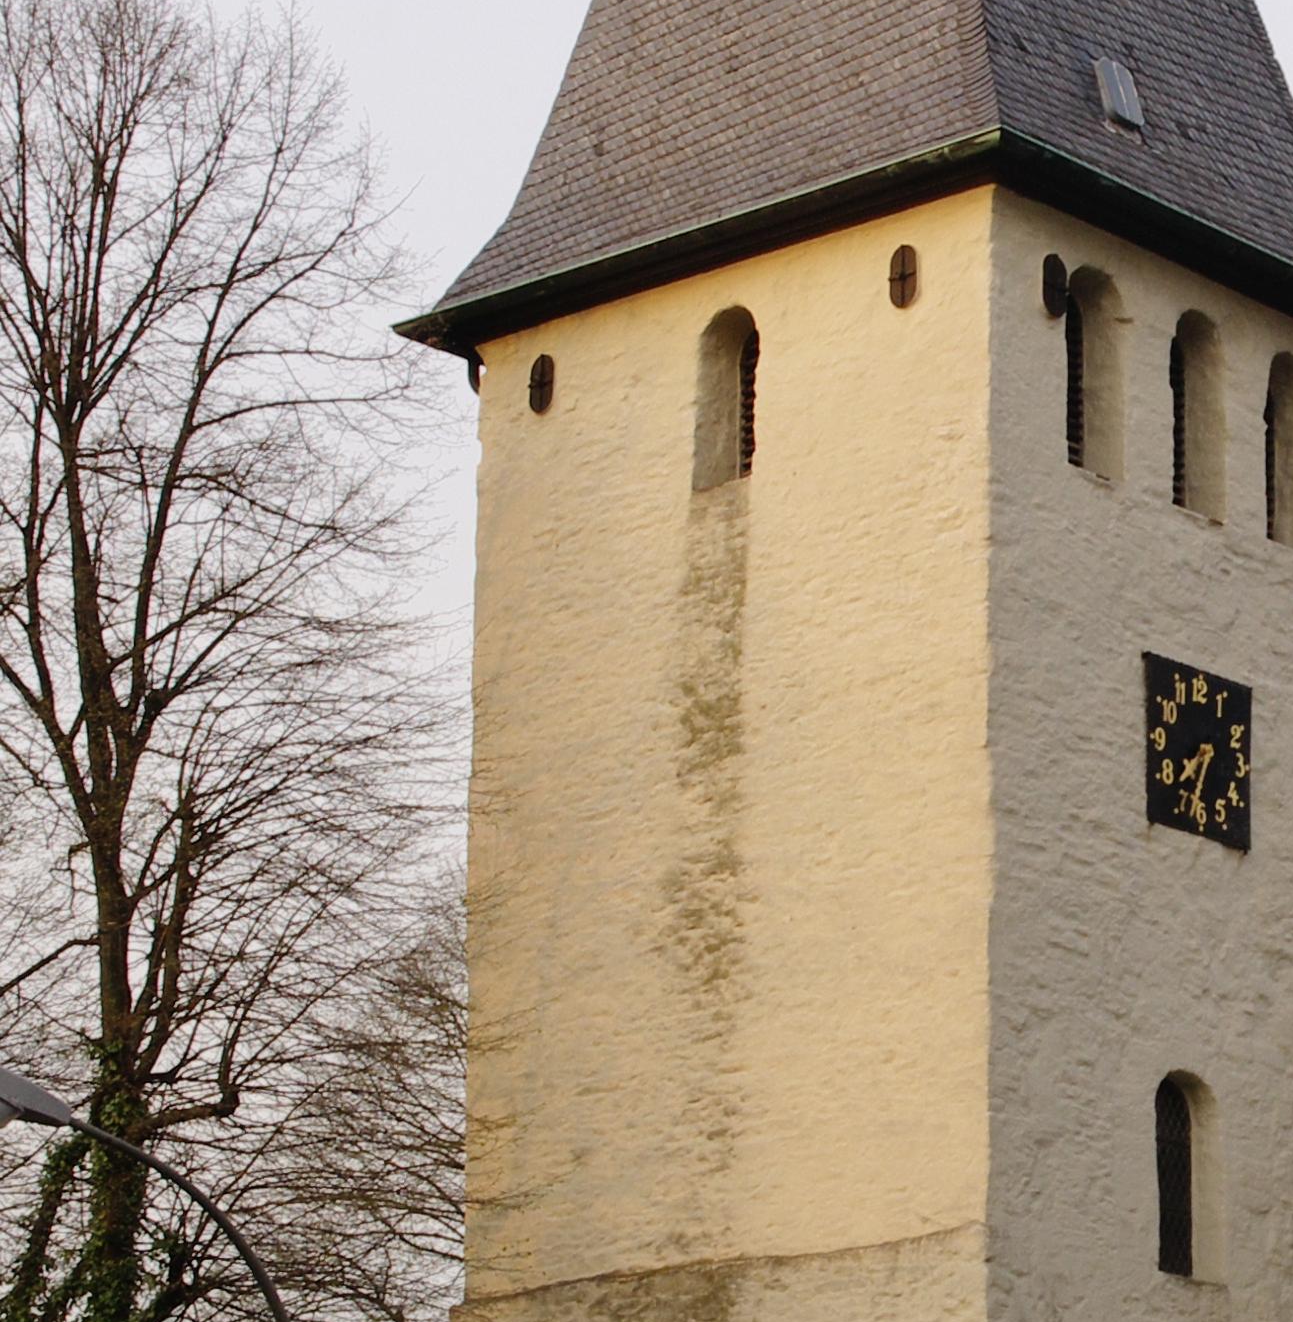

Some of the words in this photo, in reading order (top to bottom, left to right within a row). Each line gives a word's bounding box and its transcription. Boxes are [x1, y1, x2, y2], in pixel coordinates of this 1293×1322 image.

[1175, 681, 1187, 706] 11
[1191, 677, 1208, 705] 12
[1162, 698, 1178, 725] 10
[1215, 693, 1223, 718] 1
[1154, 726, 1167, 752] 9
[1229, 724, 1242, 749] 2
[1162, 758, 1175, 785] 8
[1235, 751, 1246, 778] 3
[1178, 788, 1190, 813] 7
[1226, 780, 1240, 807] 4
[1196, 801, 1207, 825] 6
[1214, 798, 1227, 823] 5
